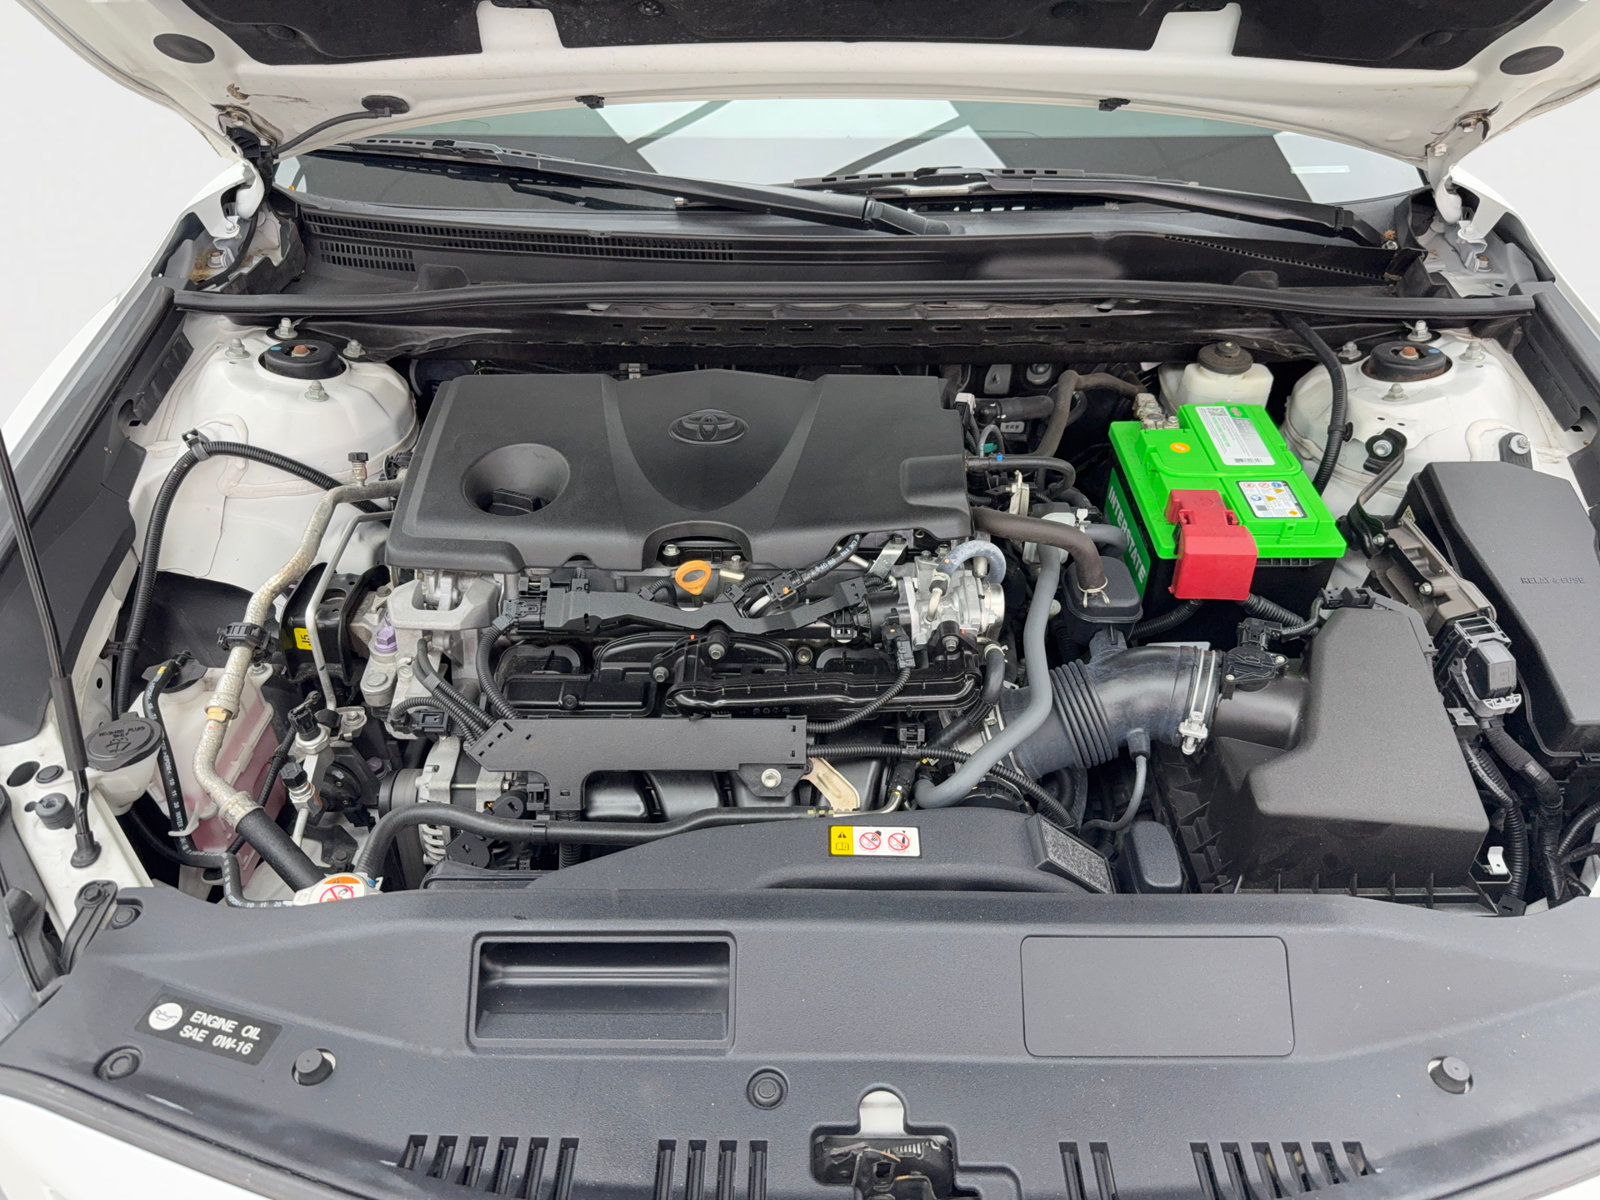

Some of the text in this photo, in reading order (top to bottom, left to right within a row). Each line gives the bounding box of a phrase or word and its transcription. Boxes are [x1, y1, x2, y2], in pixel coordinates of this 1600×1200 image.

[1108, 485, 1147, 585] INTERSTATE
[1519, 576, 1550, 585] RELAY
[1560, 576, 1586, 585] FUSE
[179, 1025, 254, 1056] SAE 0W-16
[189, 1010, 262, 1041] ENGINE OIL
